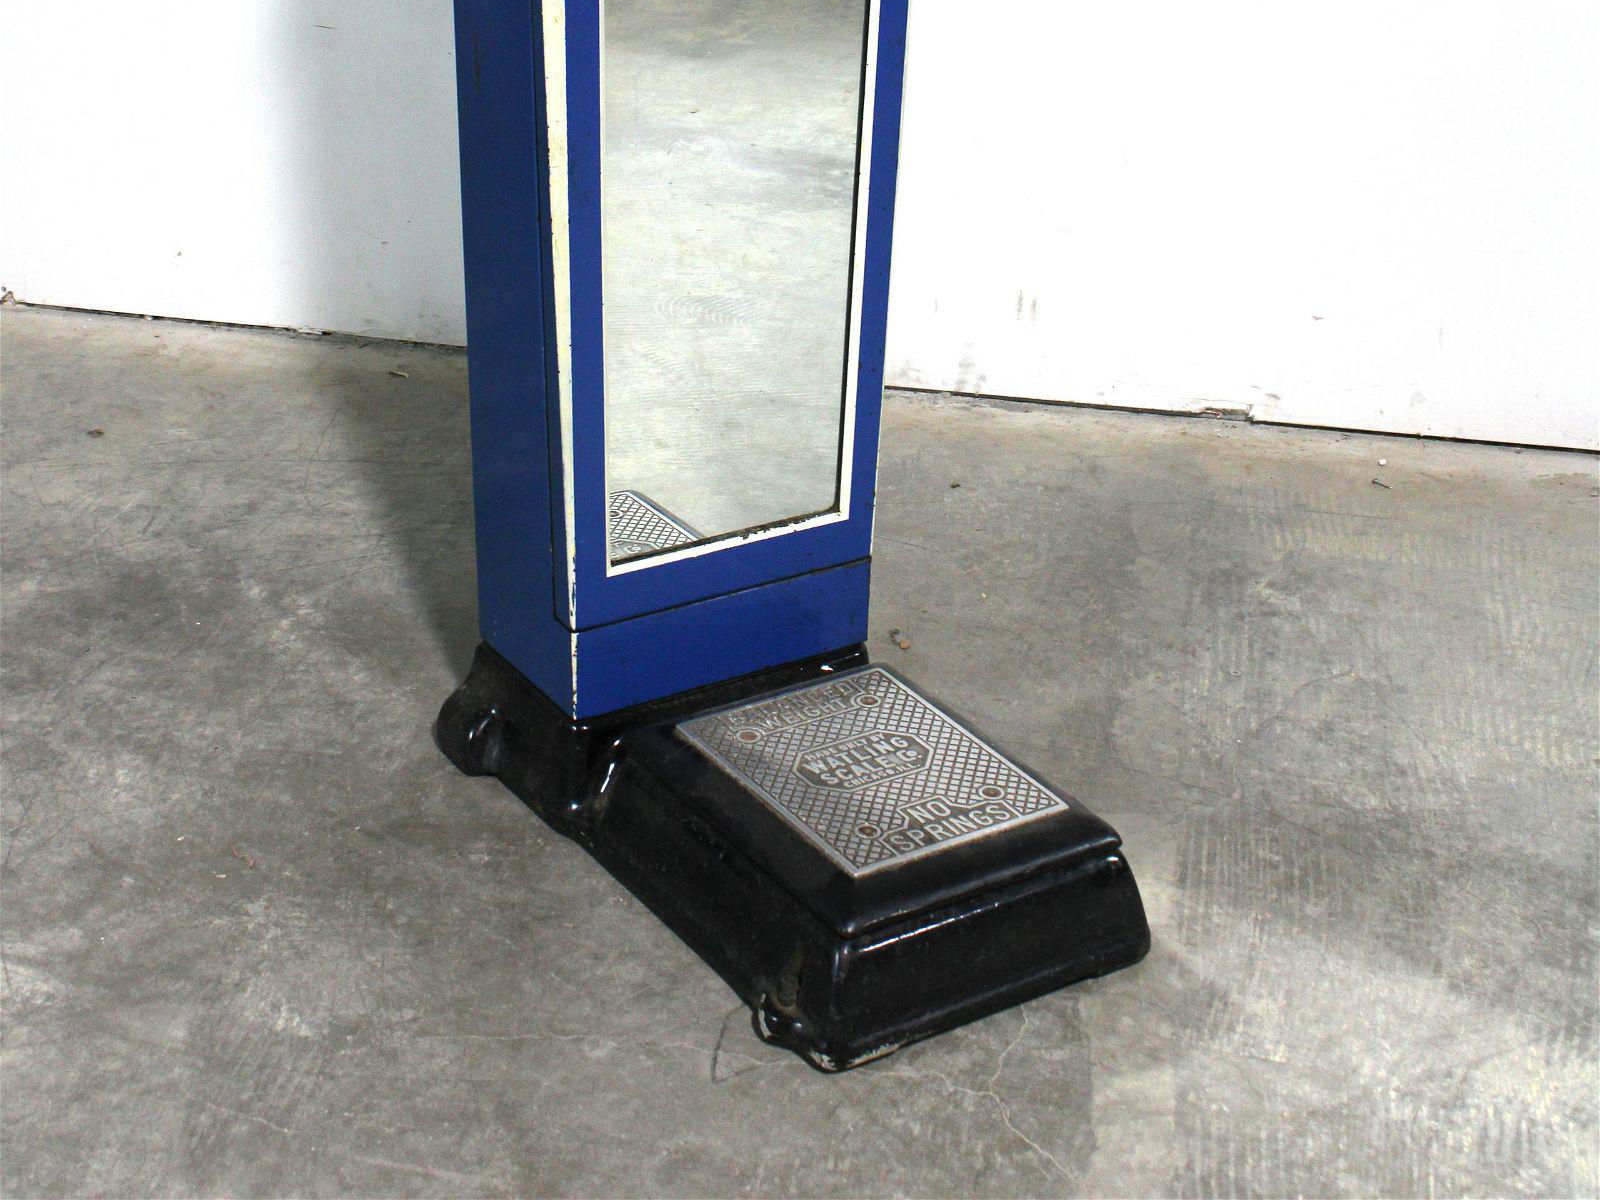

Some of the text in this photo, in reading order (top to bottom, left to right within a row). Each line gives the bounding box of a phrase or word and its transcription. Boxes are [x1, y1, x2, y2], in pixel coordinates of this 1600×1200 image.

[758, 697, 848, 730] WEIGHT
[802, 736, 909, 774] WATLING
[820, 755, 897, 785] SCALE
[890, 805, 1011, 851] SPRINGS
[907, 801, 951, 824] NO
